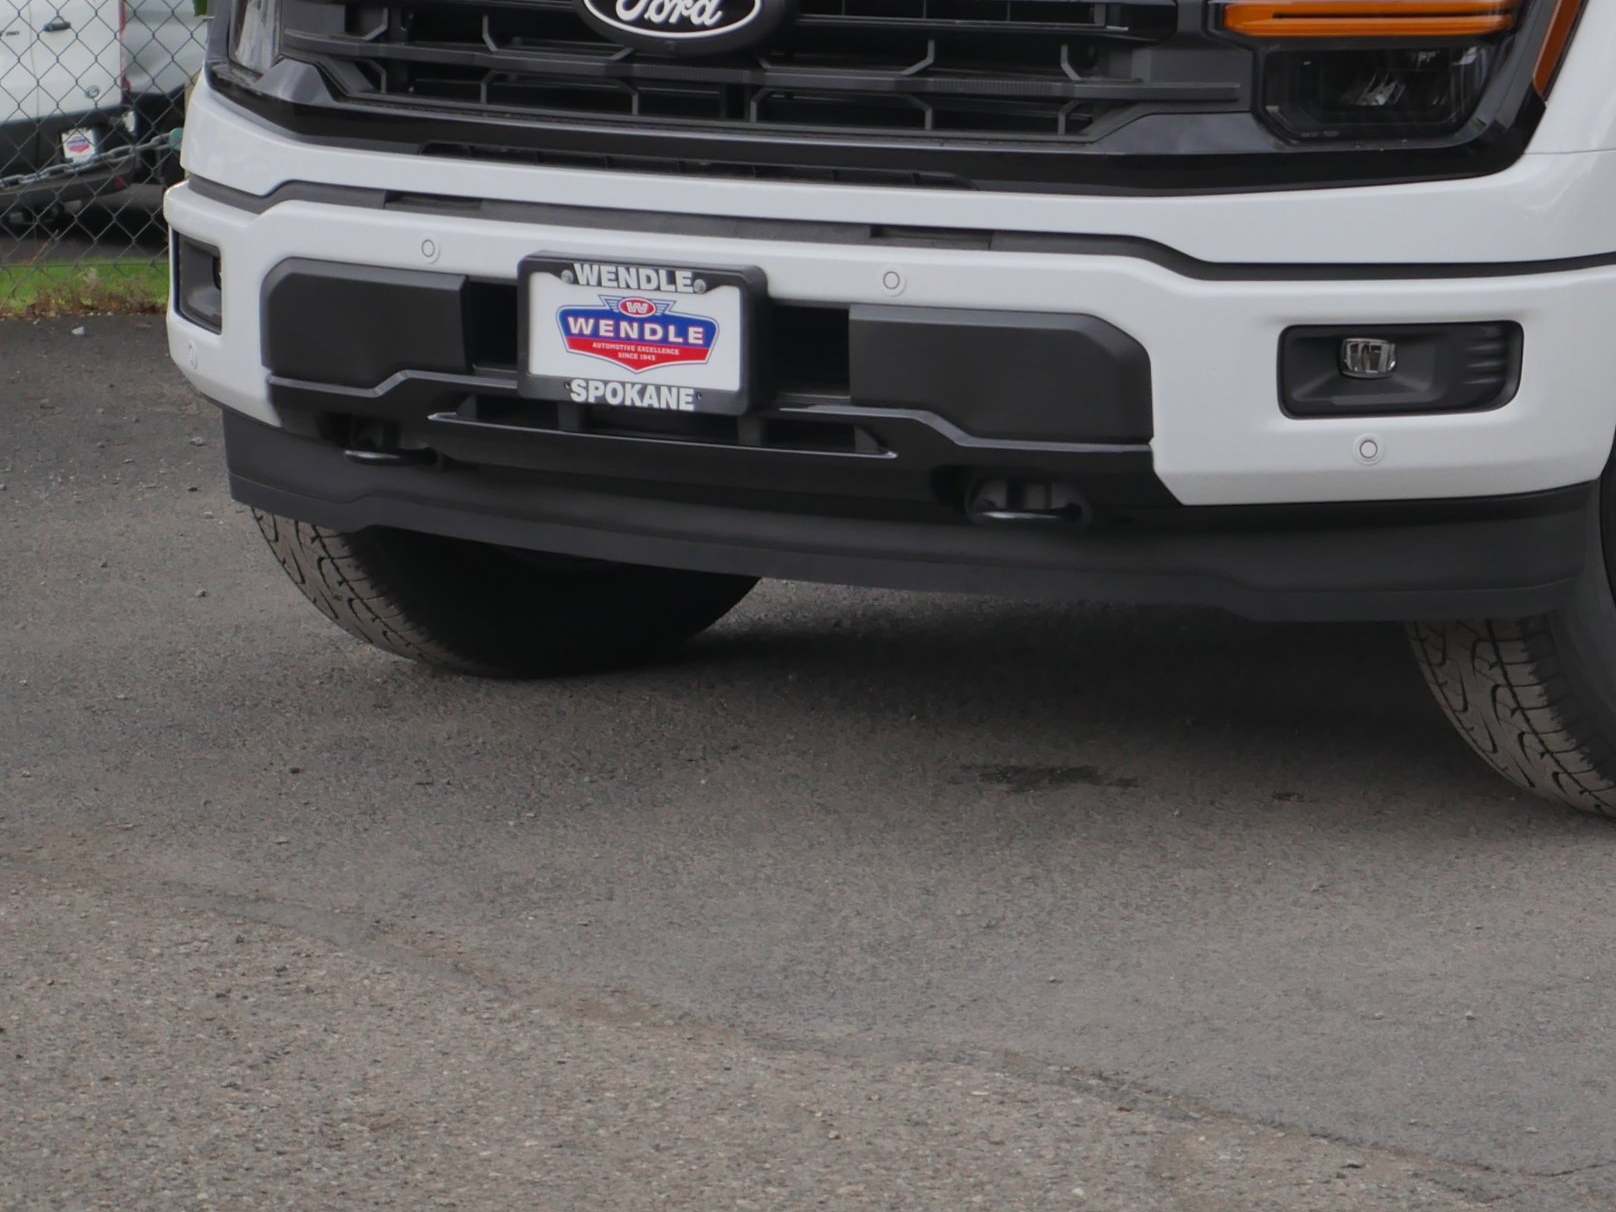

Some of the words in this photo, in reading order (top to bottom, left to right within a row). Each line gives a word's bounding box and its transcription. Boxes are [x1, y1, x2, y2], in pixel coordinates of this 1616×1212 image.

[573, 262, 695, 294] WENDLE
[626, 301, 649, 314] W
[567, 316, 705, 345] WENDLE
[592, 341, 636, 352] AUTOMOTIVE
[637, 345, 680, 356] EXCELLENCE
[617, 352, 639, 360] SINCE
[570, 378, 695, 412] SPOKANE
